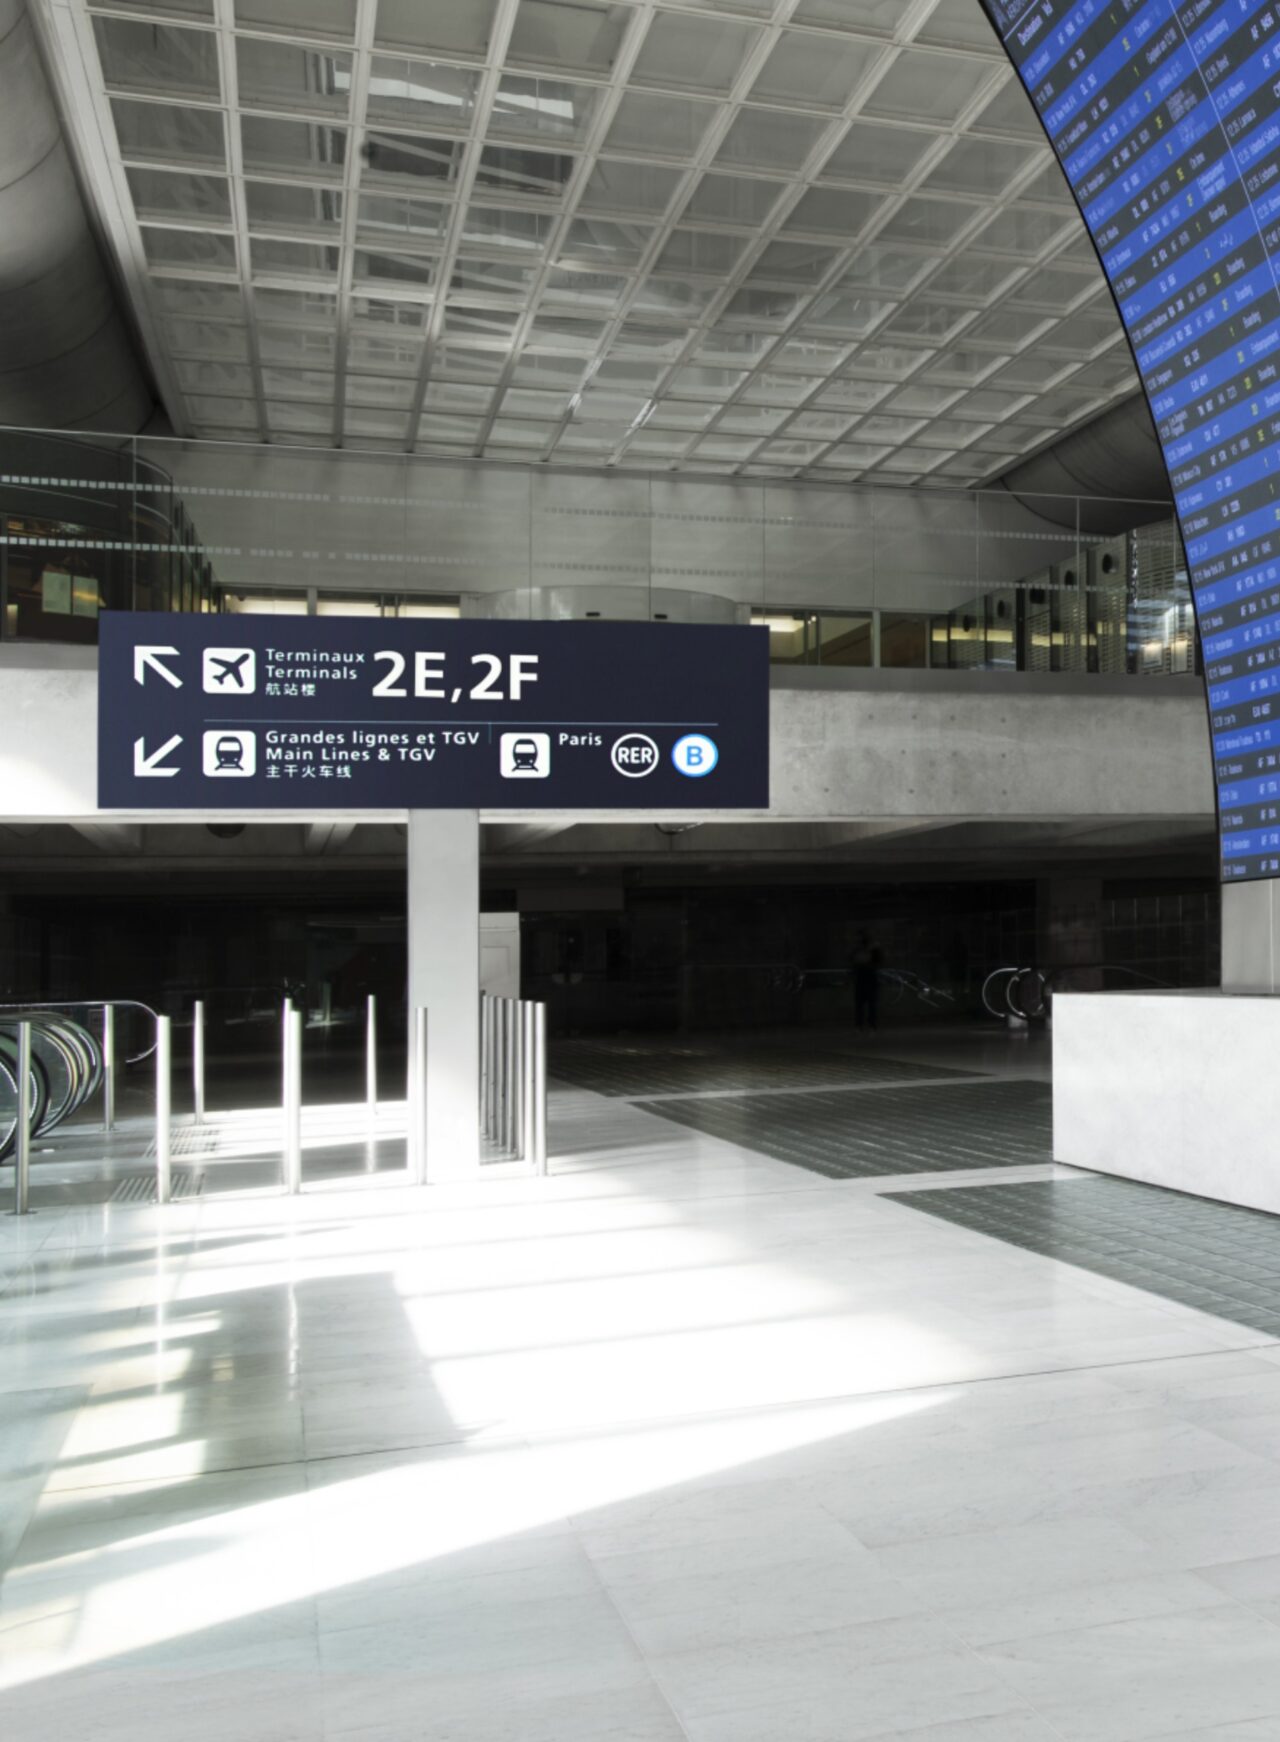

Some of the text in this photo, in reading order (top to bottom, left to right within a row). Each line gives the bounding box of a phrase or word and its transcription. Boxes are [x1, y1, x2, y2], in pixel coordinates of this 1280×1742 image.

[265, 649, 365, 663] Terminaux
[265, 665, 358, 680] Terminals
[372, 650, 539, 703] 2E,2F
[265, 683, 317, 696] 航站楼
[265, 730, 480, 748] Grandes lignes et TGV
[558, 732, 602, 746] Paris
[265, 748, 437, 761] Main Lines & TGV
[617, 746, 654, 764] RER
[265, 764, 352, 778] 主干火车线
